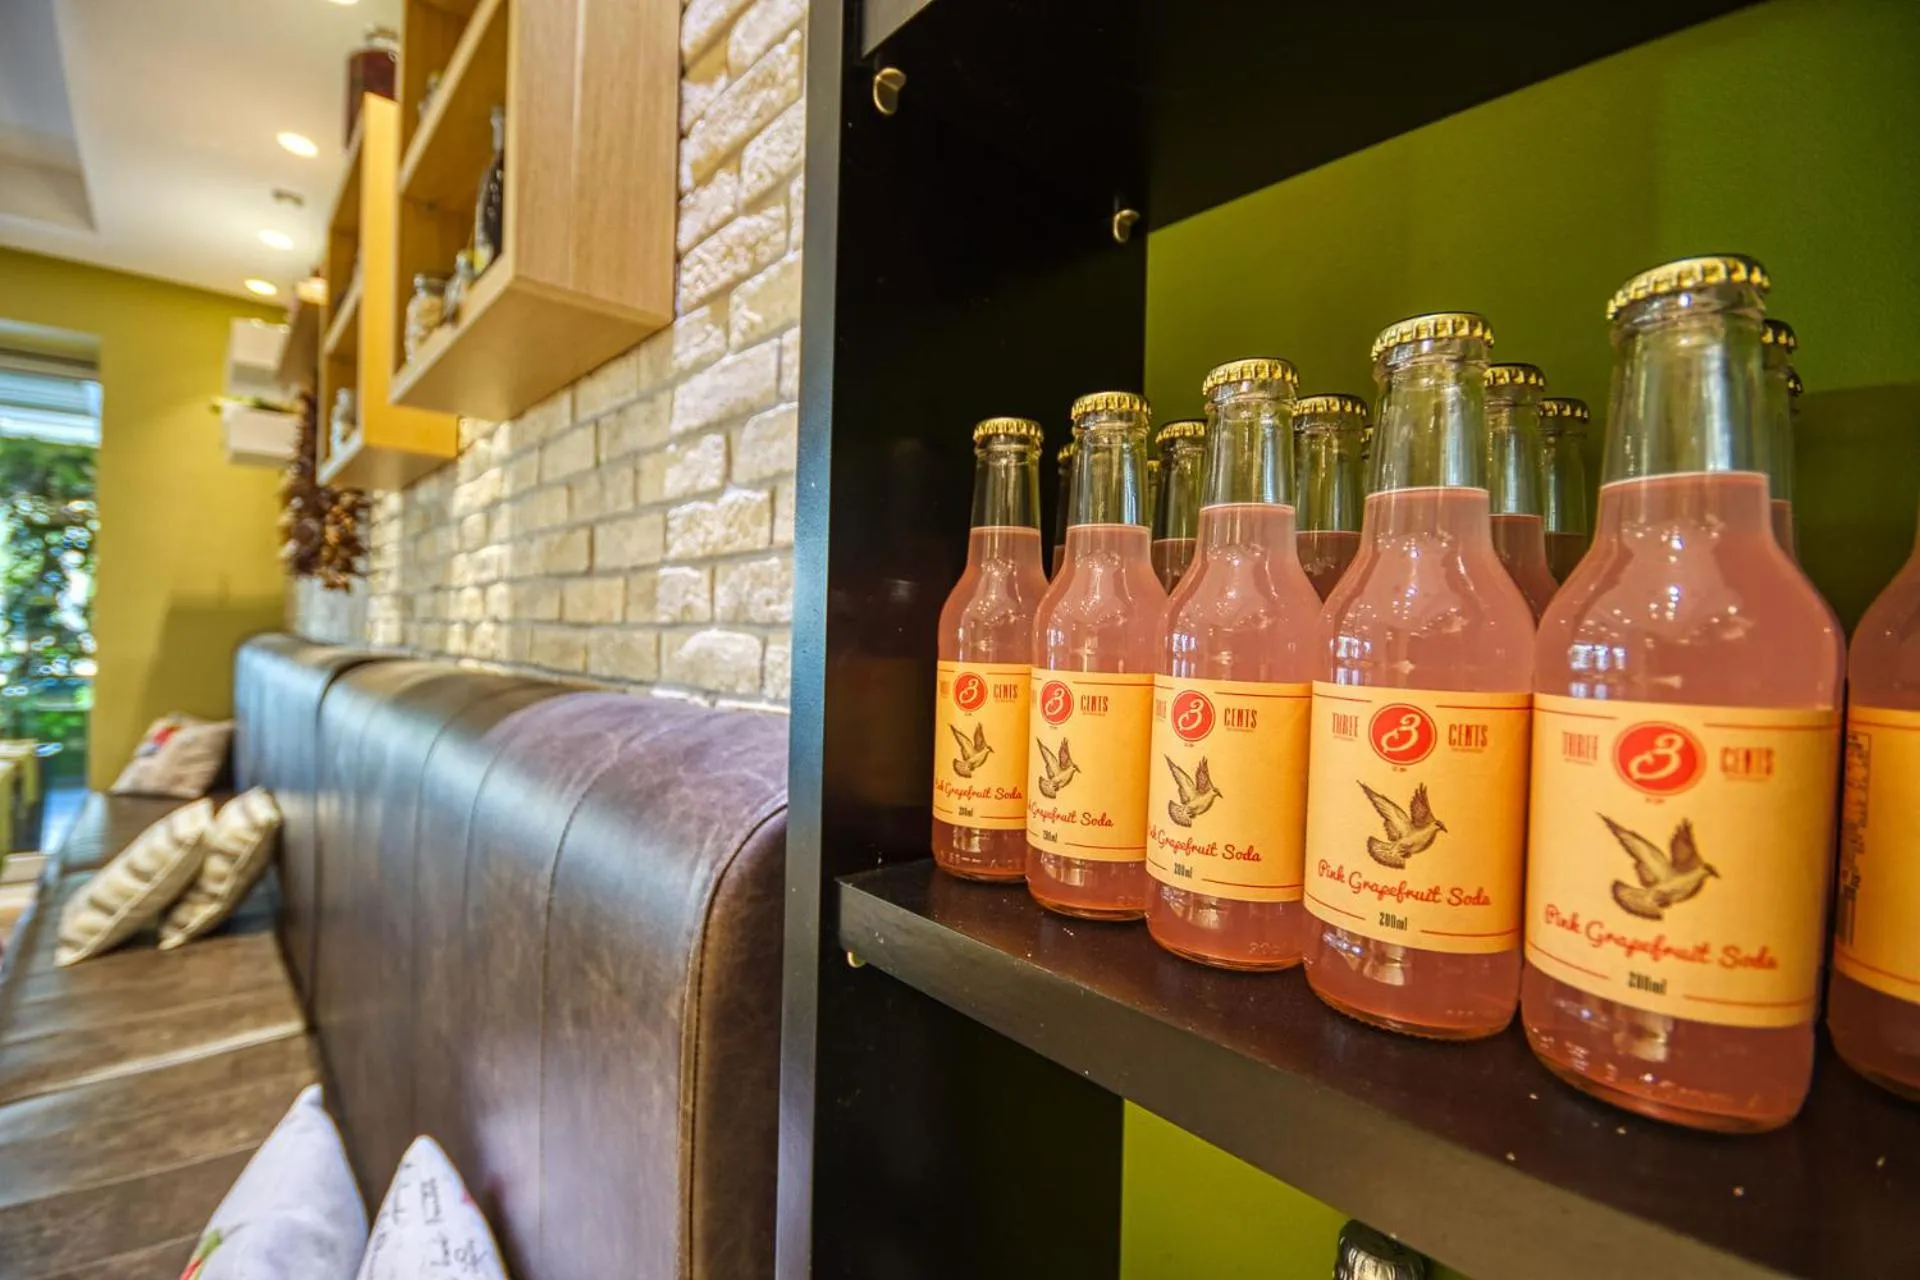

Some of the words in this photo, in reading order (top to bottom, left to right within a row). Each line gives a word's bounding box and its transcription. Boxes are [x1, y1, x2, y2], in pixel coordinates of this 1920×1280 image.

[1178, 698, 1205, 731] 3
[1224, 706, 1258, 728] CENTS
[1332, 711, 1360, 738] THREE
[1380, 713, 1422, 754] 3
[1448, 723, 1489, 748] CENTS
[1629, 732, 1685, 780] 3
[945, 782, 991, 800] Grapefruit
[994, 785, 1023, 800] Soda
[1031, 800, 1077, 824] Grapefruit
[1080, 811, 1114, 827] Soda
[1158, 828, 1218, 857] Grapefruit
[1222, 843, 1262, 862] Soda
[1317, 858, 1345, 884] Pink
[1349, 871, 1441, 904] Grapefruit
[1446, 886, 1491, 907] Soda
[1378, 911, 1408, 931] 200ml
[1543, 903, 1582, 935] Pink
[1585, 920, 1711, 962] Grapefruit
[1717, 945, 1779, 970] Soda
